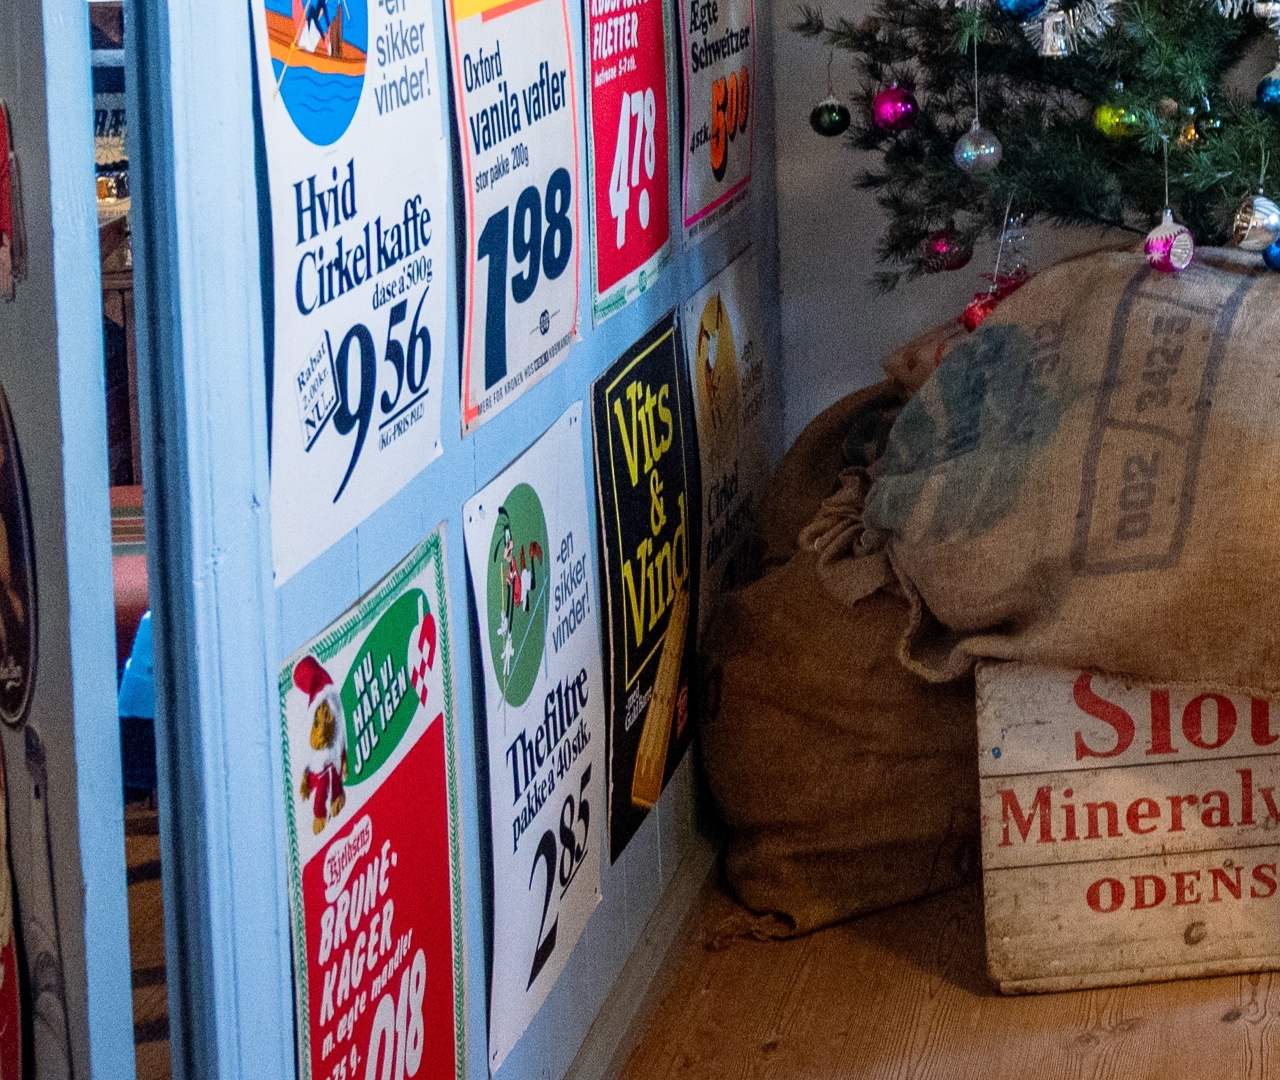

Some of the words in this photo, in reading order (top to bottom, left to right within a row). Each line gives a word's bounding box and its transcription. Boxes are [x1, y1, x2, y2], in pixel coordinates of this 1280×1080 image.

[375, 19, 426, 68] sikker
[463, 39, 503, 94] Oxford
[593, 11, 639, 61] FILETTER
[691, 24, 751, 74] Schweitzer
[373, 57, 432, 117] vinder!
[469, 80, 522, 157] vanila
[522, 60, 568, 125] vafler
[293, 157, 358, 248] Hvid
[474, 166, 489, 194] stor
[489, 152, 511, 191] pakke
[295, 225, 373, 316] Cirkel
[375, 194, 433, 274] kaffe
[477, 166, 574, 392] 198
[296, 341, 327, 392] Rabat
[614, 380, 674, 488] Vits
[650, 468, 667, 536] &
[551, 582, 591, 654] vinder!
[554, 552, 587, 613] sikker
[352, 677, 381, 741] HAR
[380, 652, 395, 690] VI
[353, 650, 374, 697] NU
[353, 725, 380, 775] JUL
[379, 665, 408, 732] IGEN
[505, 667, 590, 807] Thefiltre
[526, 761, 593, 993] 285
[319, 898, 394, 1028] KAGER
[370, 927, 413, 1002] mandler
